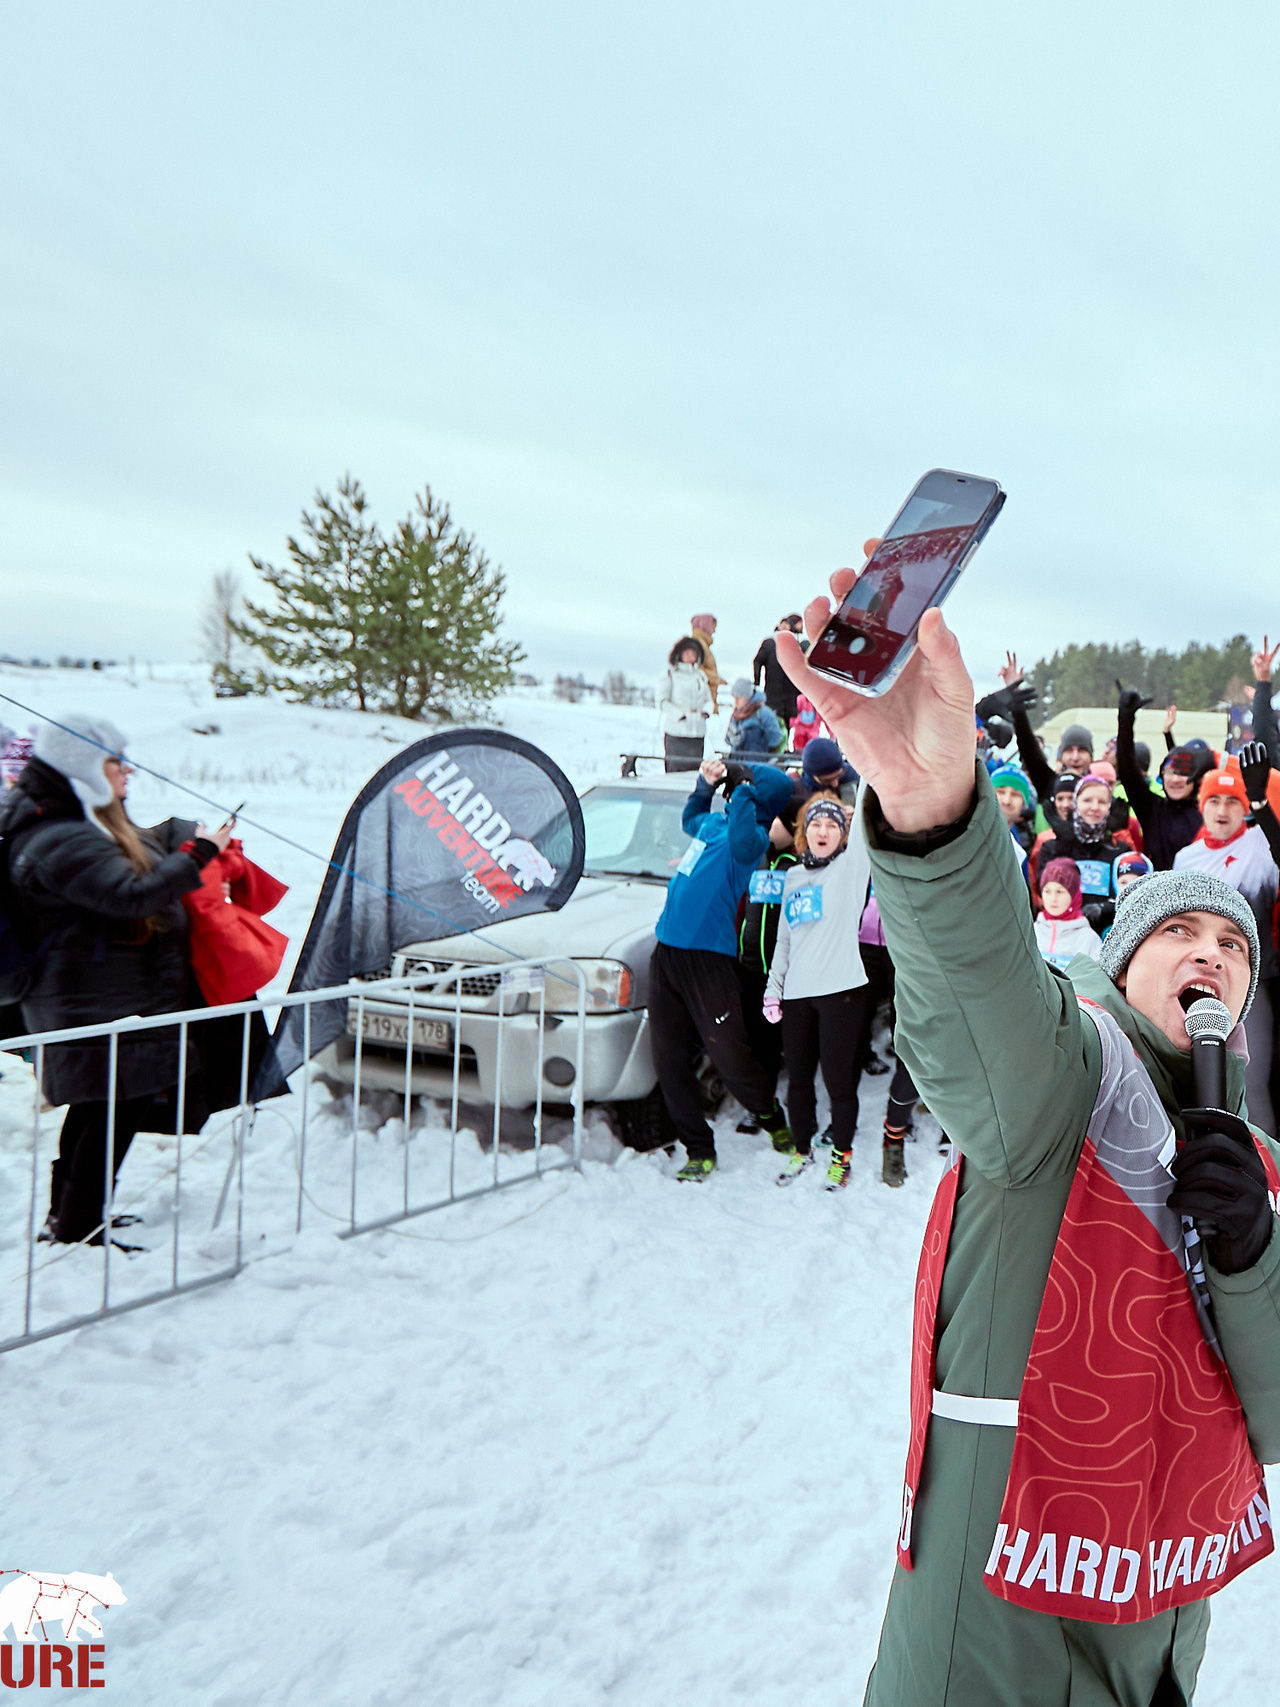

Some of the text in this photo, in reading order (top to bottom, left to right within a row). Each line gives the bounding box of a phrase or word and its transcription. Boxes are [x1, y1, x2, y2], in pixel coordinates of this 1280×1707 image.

[415, 750, 511, 850] HARD
[394, 778, 524, 908] ADVENTURE
[460, 869, 501, 914] team
[756, 880, 781, 895] 563
[1082, 872, 1101, 886] 52
[789, 897, 811, 918] 492
[419, 1021, 444, 1040] 178
[985, 1523, 1141, 1604] HARD
[1149, 1522, 1235, 1599] HAR
